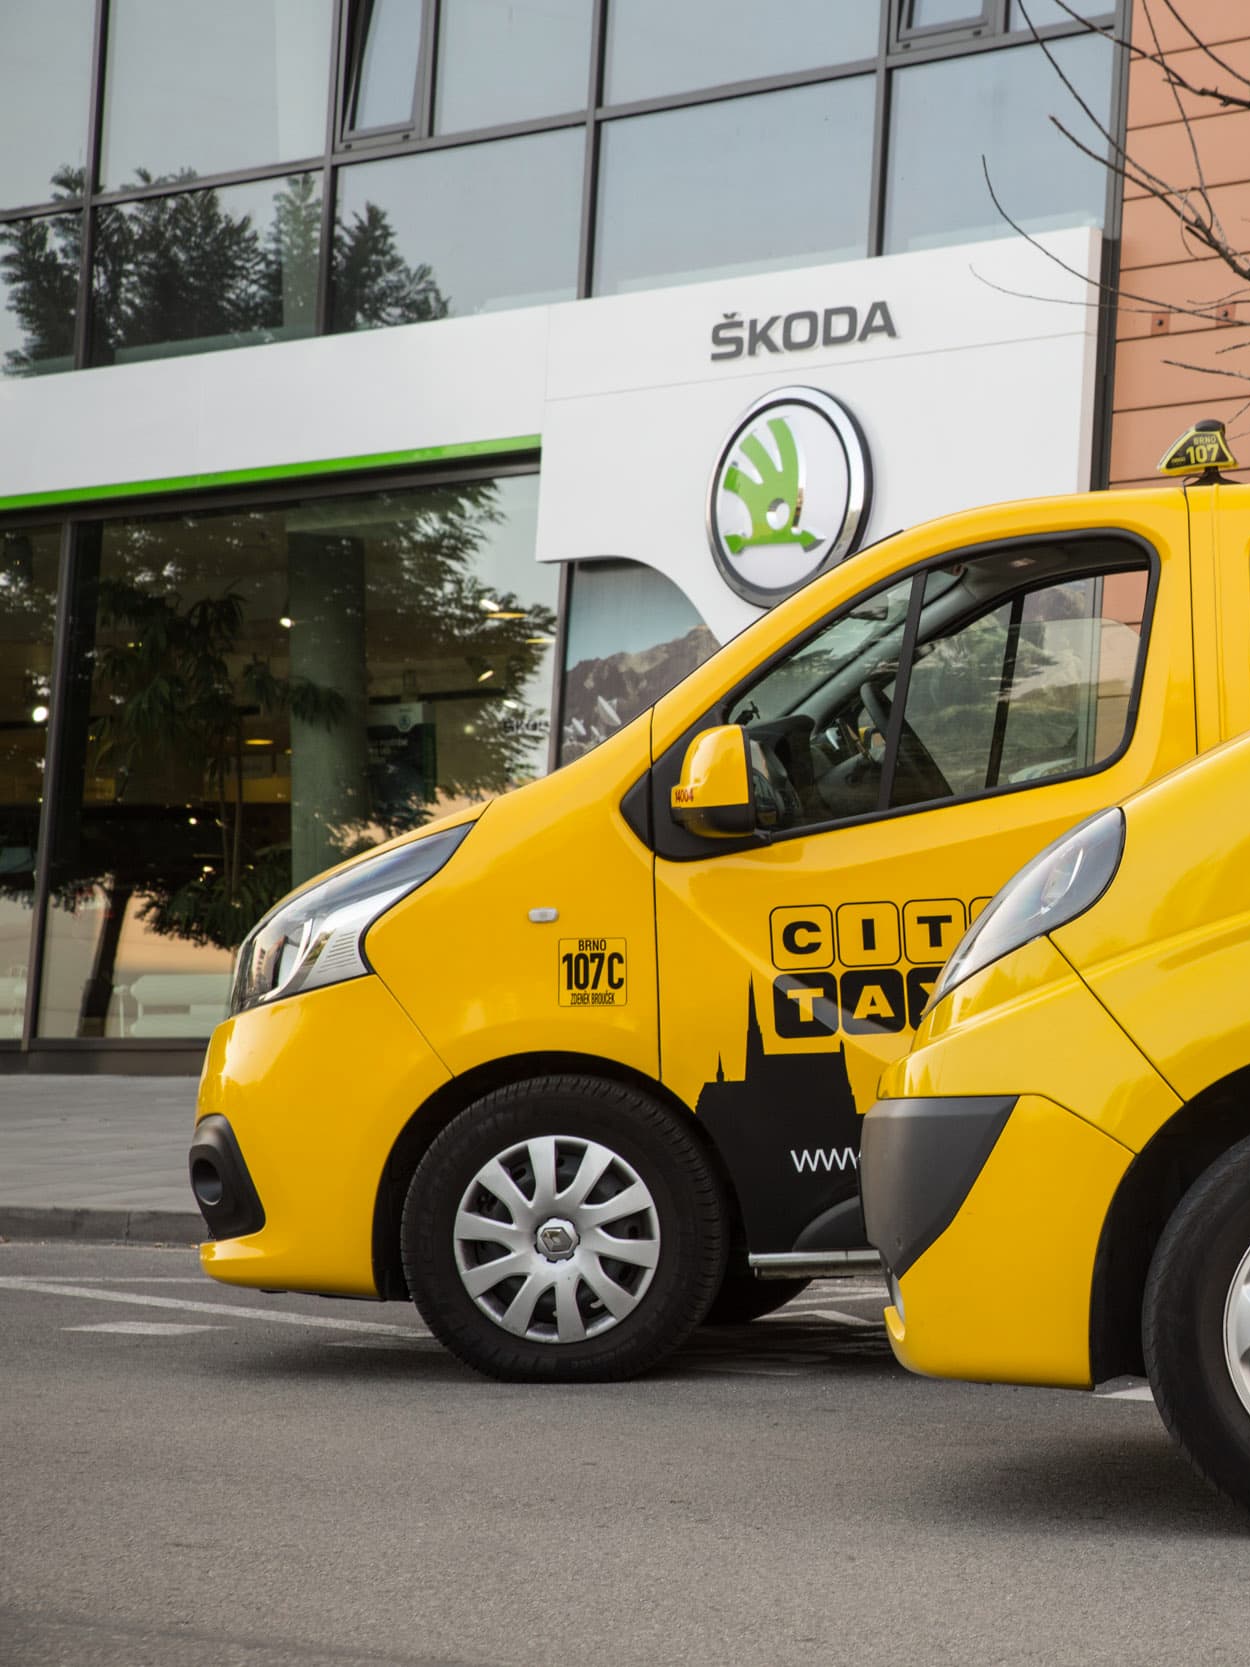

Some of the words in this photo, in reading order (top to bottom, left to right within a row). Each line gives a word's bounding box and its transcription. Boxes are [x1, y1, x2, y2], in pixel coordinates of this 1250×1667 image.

[711, 300, 898, 361] ŠKODA
[1193, 434, 1217, 446] BRNO
[1186, 443, 1219, 465] 107
[578, 939, 607, 951] BRNO
[562, 952, 624, 990] 107C
